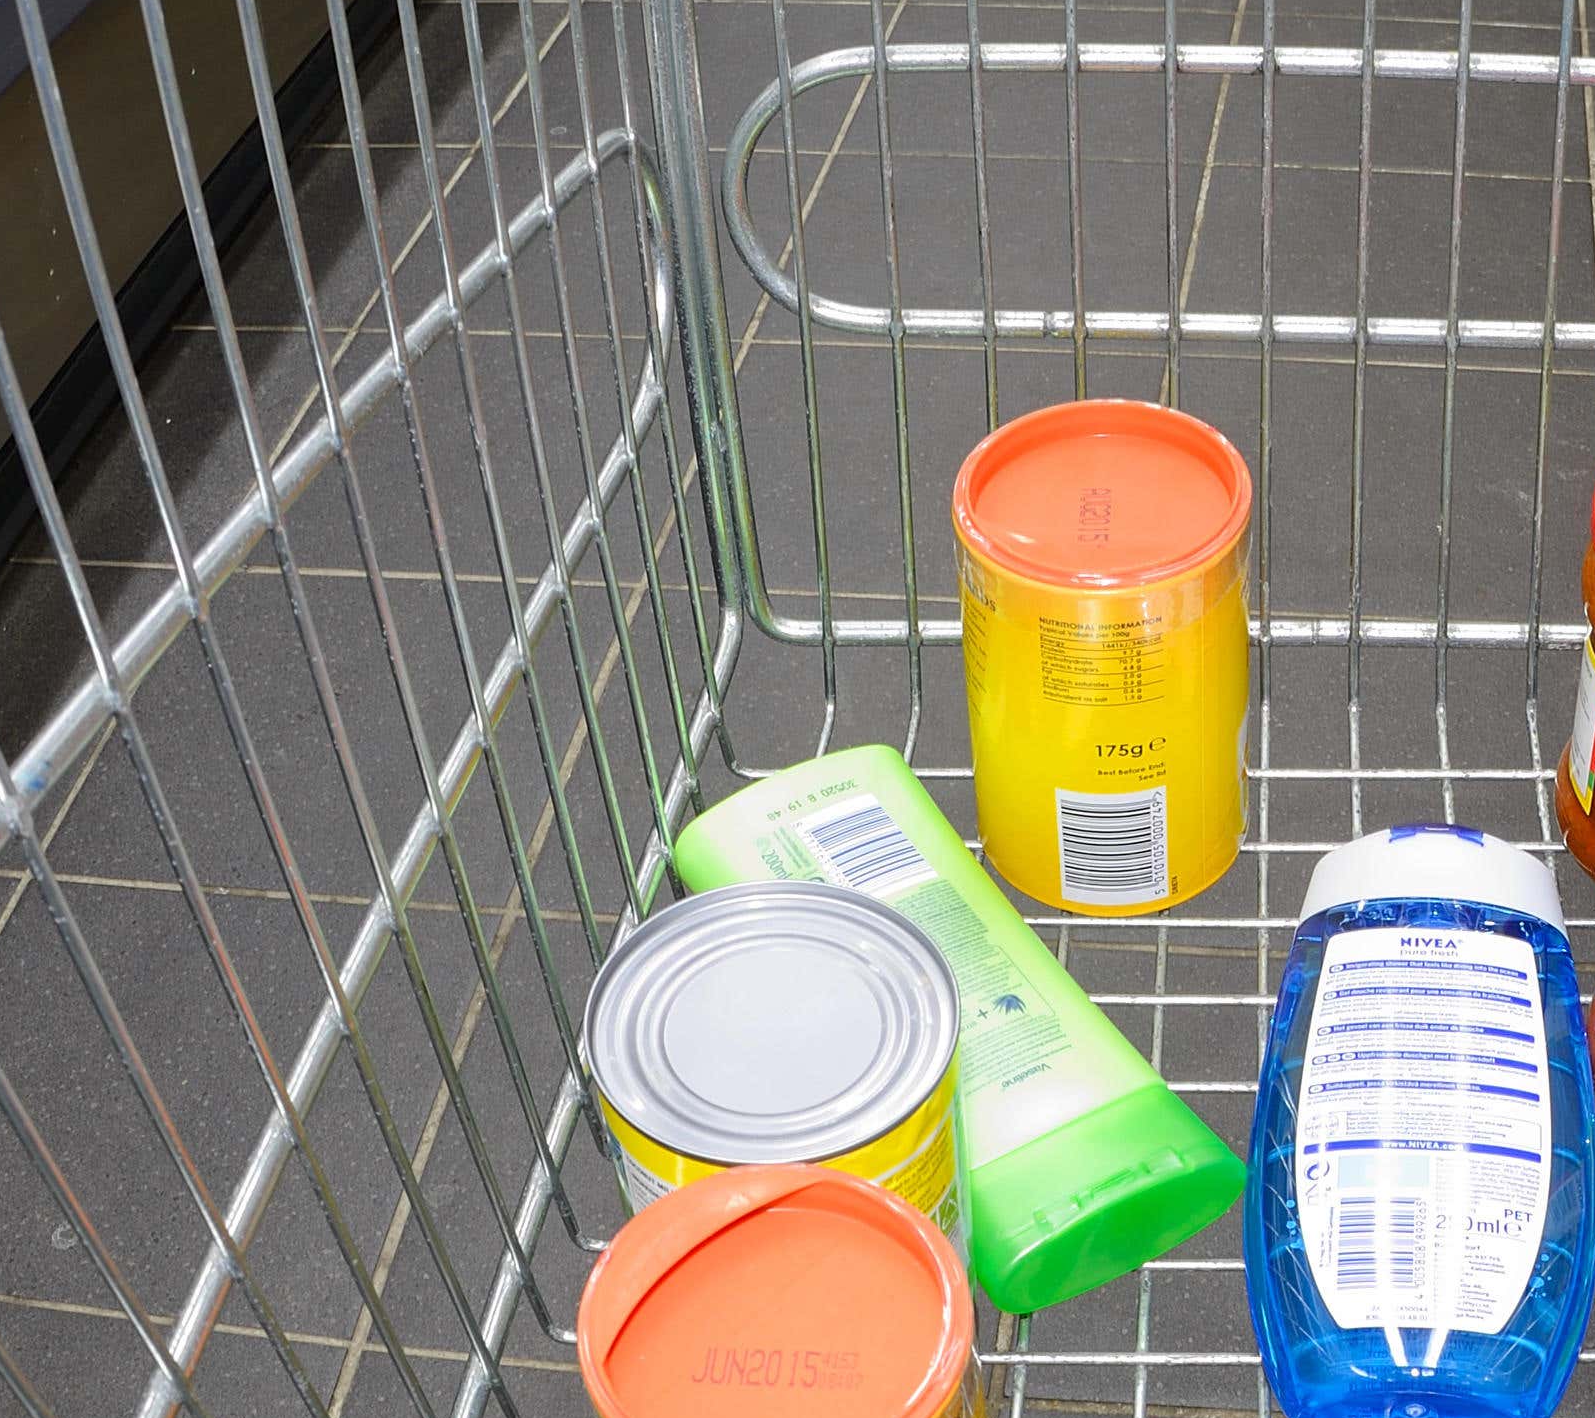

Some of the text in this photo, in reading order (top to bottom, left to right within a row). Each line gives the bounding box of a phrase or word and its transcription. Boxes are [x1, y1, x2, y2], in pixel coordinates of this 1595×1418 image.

[1039, 615, 1163, 631] NUTRITIONAL INFORMATION
[1096, 743, 1143, 758] 175g
[1138, 773, 1155, 781] See
[1400, 938, 1457, 948] NIVEA
[1502, 1208, 1533, 1223] PET
